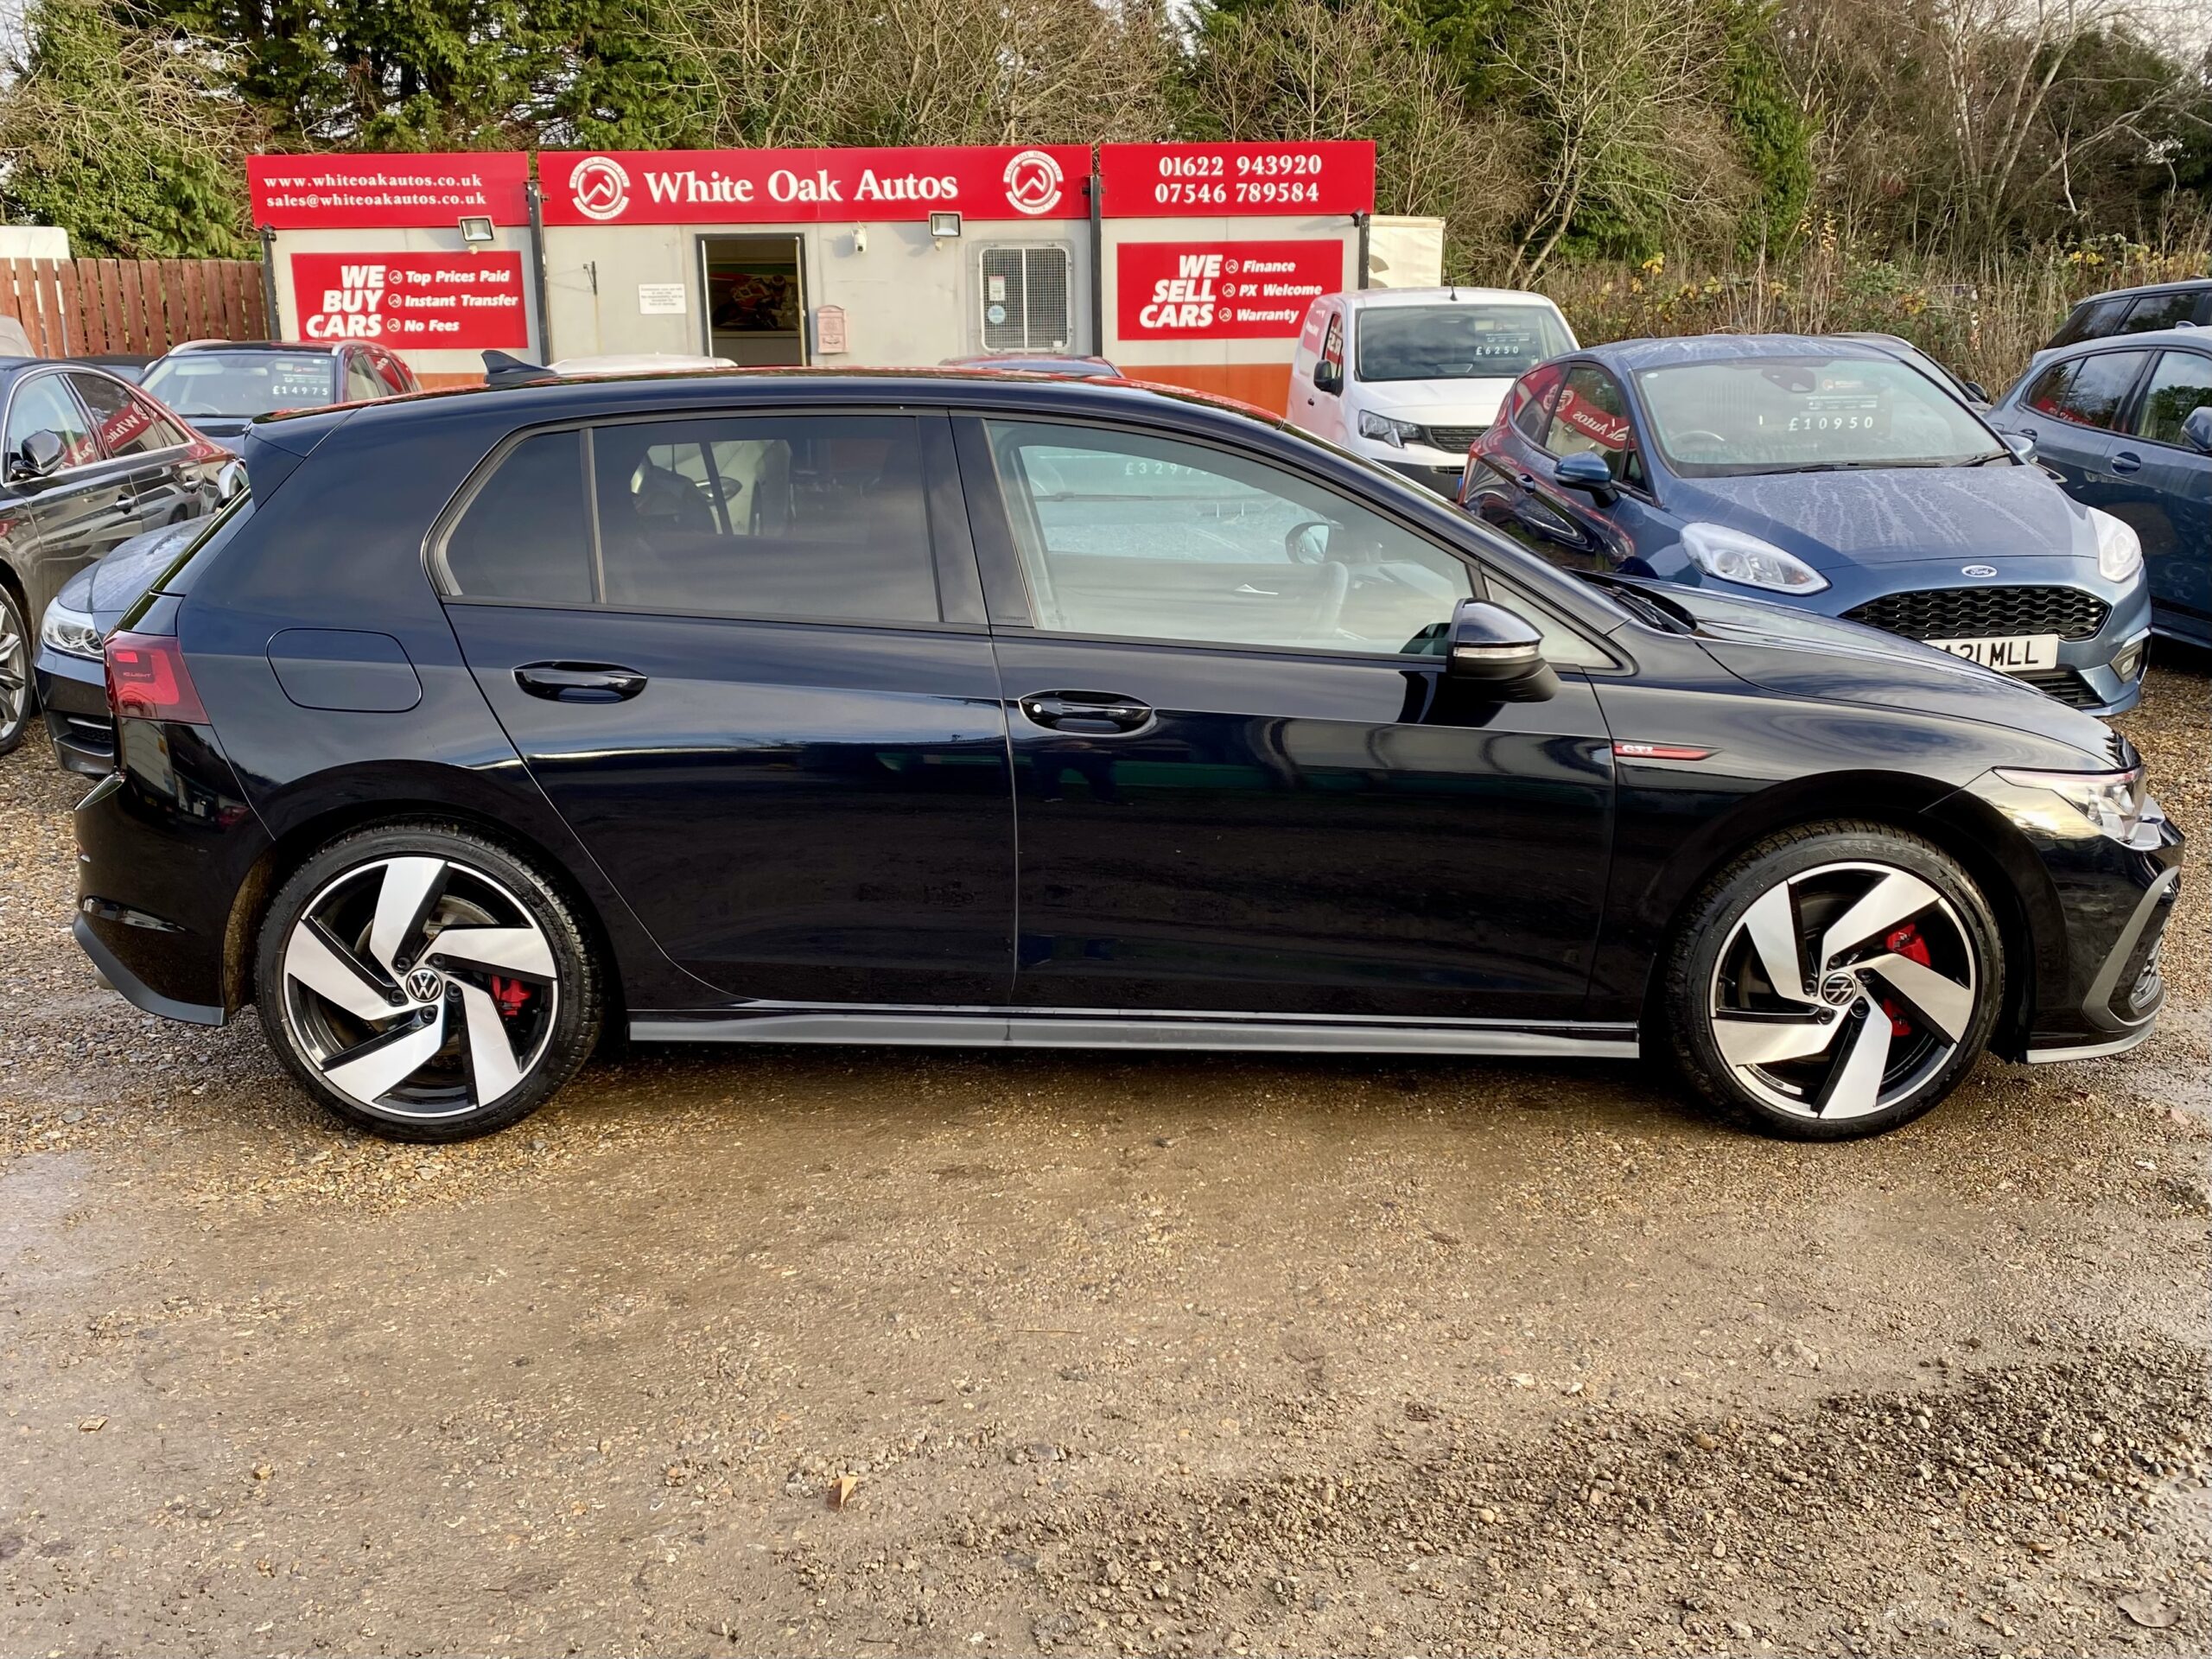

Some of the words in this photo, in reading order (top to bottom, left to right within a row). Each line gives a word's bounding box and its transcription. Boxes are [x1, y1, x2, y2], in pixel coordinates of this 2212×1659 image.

[1159, 156, 1224, 176] 01622
[1236, 155, 1322, 175] 943920
[264, 173, 482, 188] www.whiteoakautos.co.uk
[644, 170, 753, 203] White
[767, 169, 843, 202] Oak
[853, 168, 958, 200] Autos
[266, 192, 486, 207] sales@whiteoakautos.co.uk
[1154, 183, 1227, 203] 07546
[1236, 183, 1319, 202] 789584
[1179, 254, 1224, 278] WE
[1243, 260, 1296, 272] Finance
[340, 264, 386, 288] WE
[405, 270, 431, 286] Top
[435, 270, 475, 283] Prices
[480, 270, 511, 283] Paid
[1152, 279, 1217, 302] SELL
[1238, 284, 1258, 296] PX
[1263, 283, 1322, 296] Welcome
[322, 290, 385, 313] BUY
[404, 295, 456, 307] Instant
[461, 294, 518, 307] Transfer
[1139, 303, 1215, 328] CARS
[1236, 308, 1300, 323] Warranty
[305, 315, 383, 338] CARS
[404, 320, 425, 333] No
[429, 319, 460, 332] Fees
[1476, 346, 1519, 355] £6250
[272, 385, 328, 396] £14975
[1789, 416, 1873, 432] £10950
[1125, 462, 1208, 475] £3297
[1989, 640, 2039, 668] MLL
